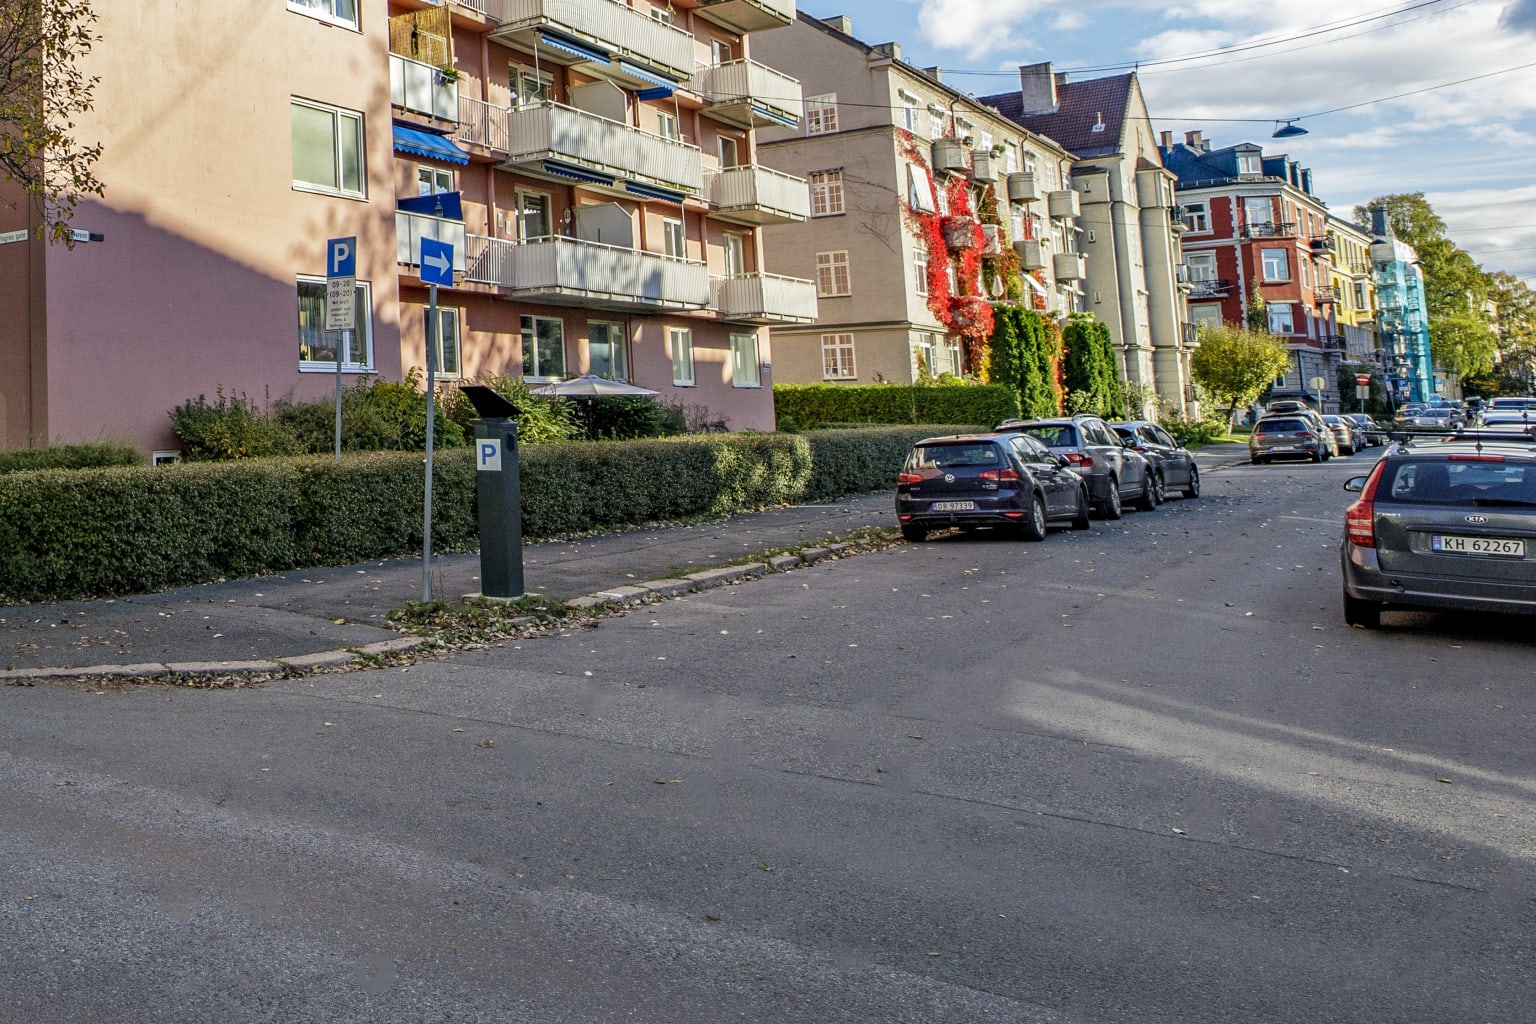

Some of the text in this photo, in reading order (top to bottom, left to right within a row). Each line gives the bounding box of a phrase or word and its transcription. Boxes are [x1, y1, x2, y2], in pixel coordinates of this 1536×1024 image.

[334, 243, 350, 273] P
[482, 444, 496, 465] P
[1467, 515, 1486, 523] KIA
[1444, 538, 1521, 553] KH 62267
